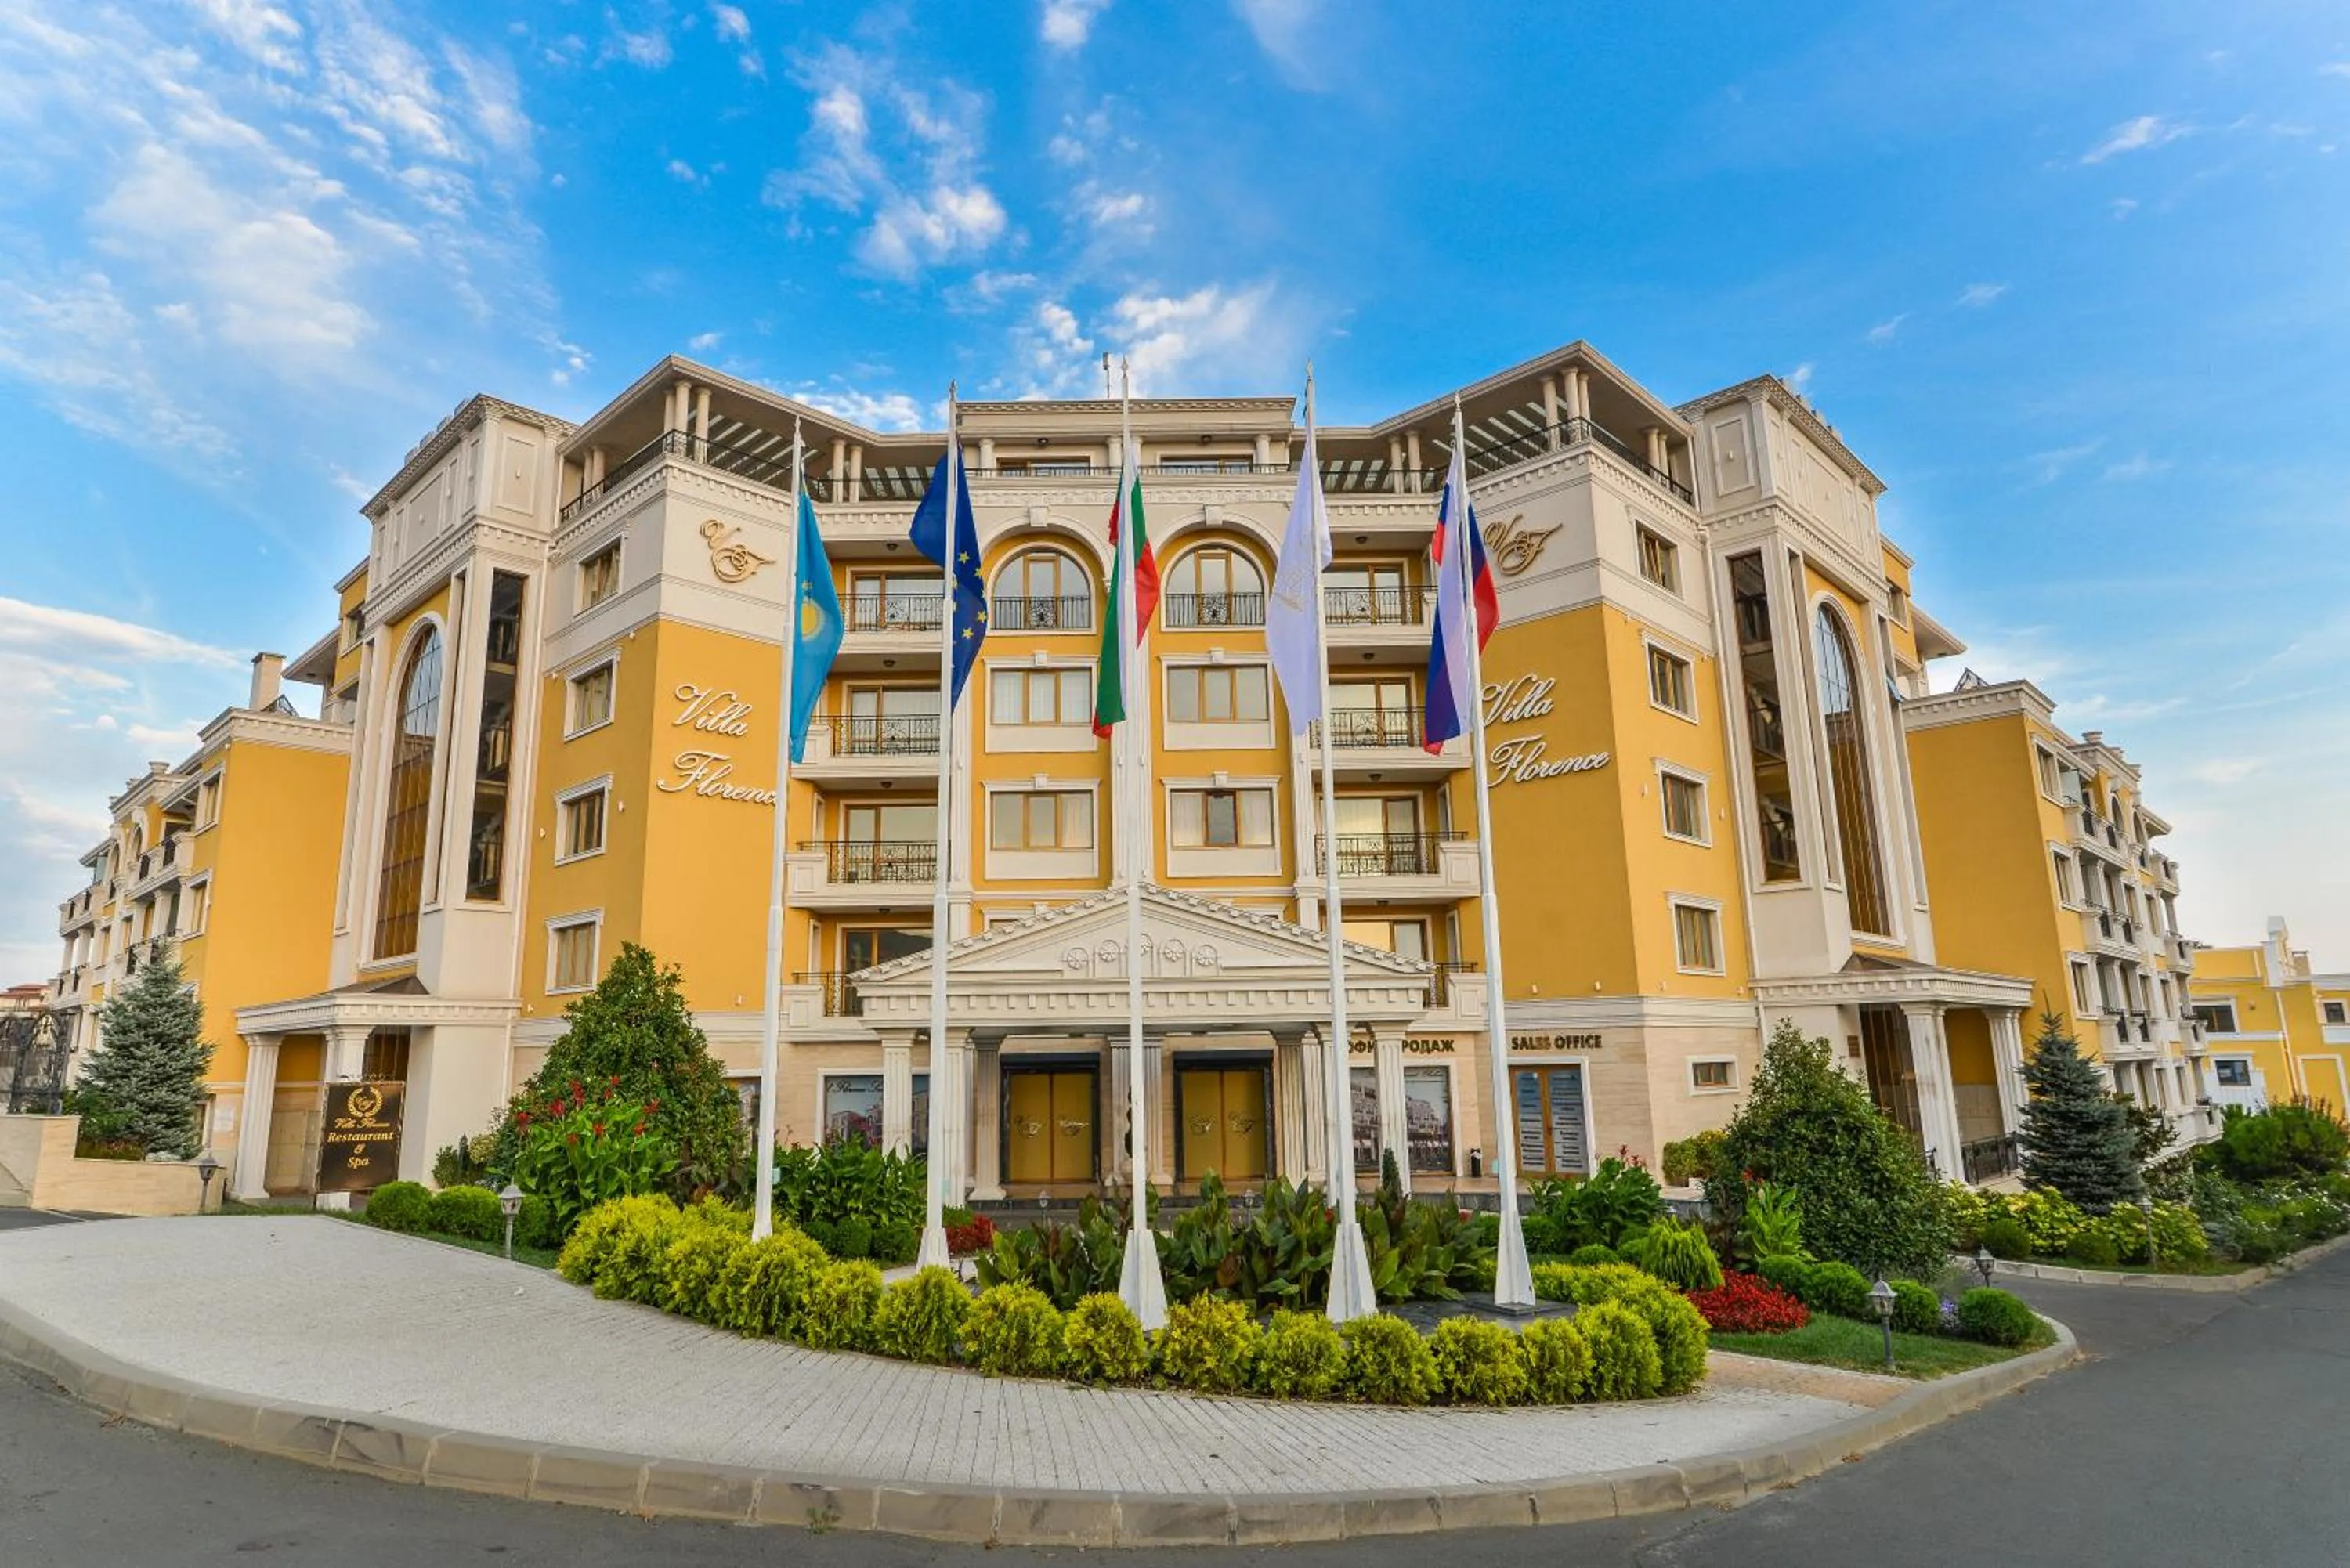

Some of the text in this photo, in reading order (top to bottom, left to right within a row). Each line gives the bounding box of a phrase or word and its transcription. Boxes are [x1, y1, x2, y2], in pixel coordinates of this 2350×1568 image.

[672, 683, 753, 737] Villa
[1481, 674, 1556, 728] Villa
[656, 750, 777, 806] Florenc
[1487, 733, 1611, 788] Florence
[1401, 1039, 1455, 1055] РОДАЖ
[1511, 1035, 1603, 1050] SALES OFFICE
[327, 1132, 395, 1143] Restaurant
[347, 1157, 371, 1169] Spa
